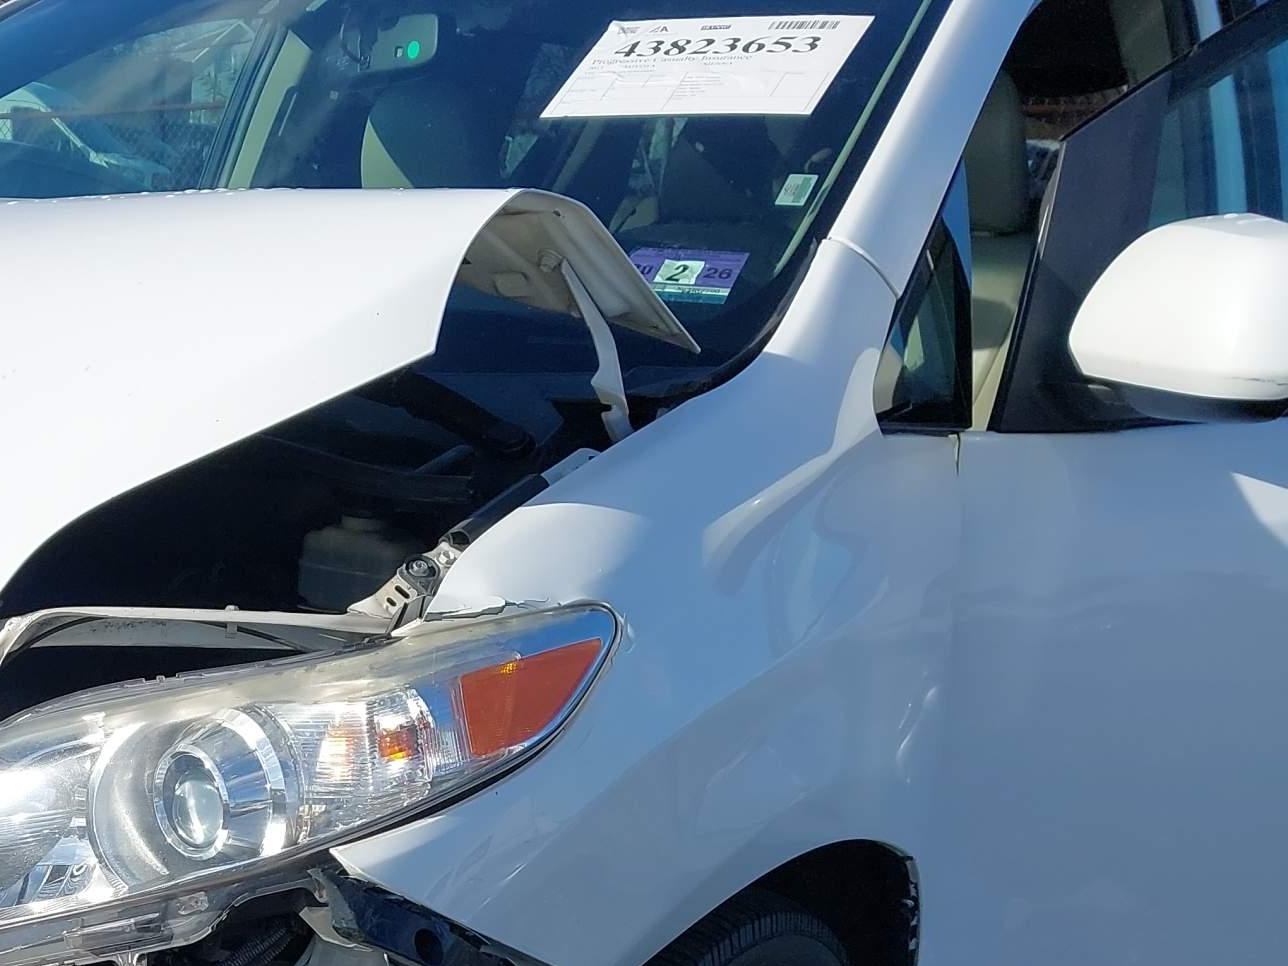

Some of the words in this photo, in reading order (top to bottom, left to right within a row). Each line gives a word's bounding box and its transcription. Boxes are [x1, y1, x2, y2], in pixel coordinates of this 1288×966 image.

[614, 36, 823, 58] 43823653
[664, 264, 690, 283] 2
[703, 267, 733, 280] 26
